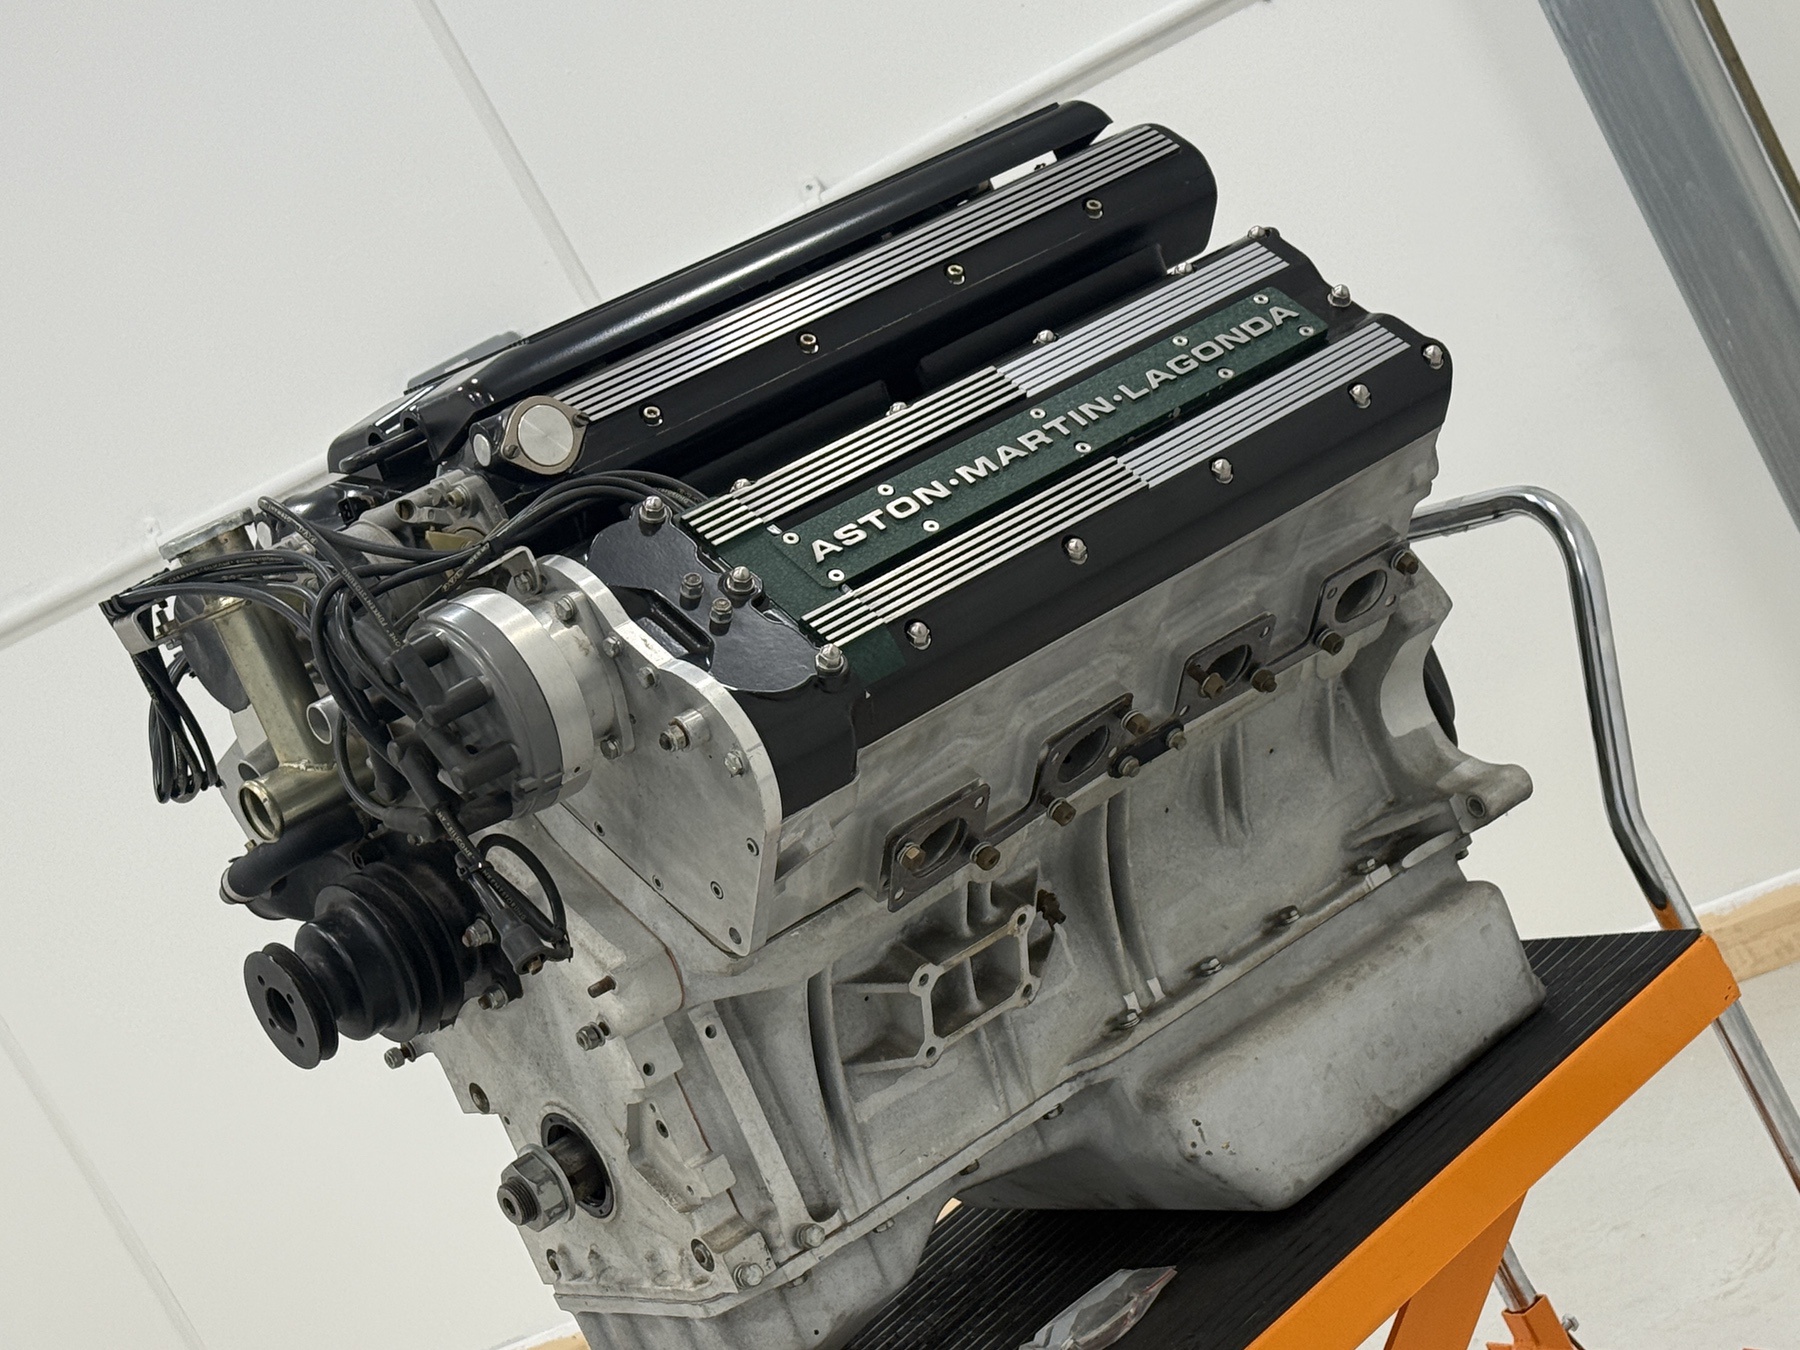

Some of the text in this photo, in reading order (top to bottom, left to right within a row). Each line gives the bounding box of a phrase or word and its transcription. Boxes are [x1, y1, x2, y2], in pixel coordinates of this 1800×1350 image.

[811, 306, 1299, 563] ASTON MARTIN LAGONDA
[448, 826, 473, 857] SILICONE
